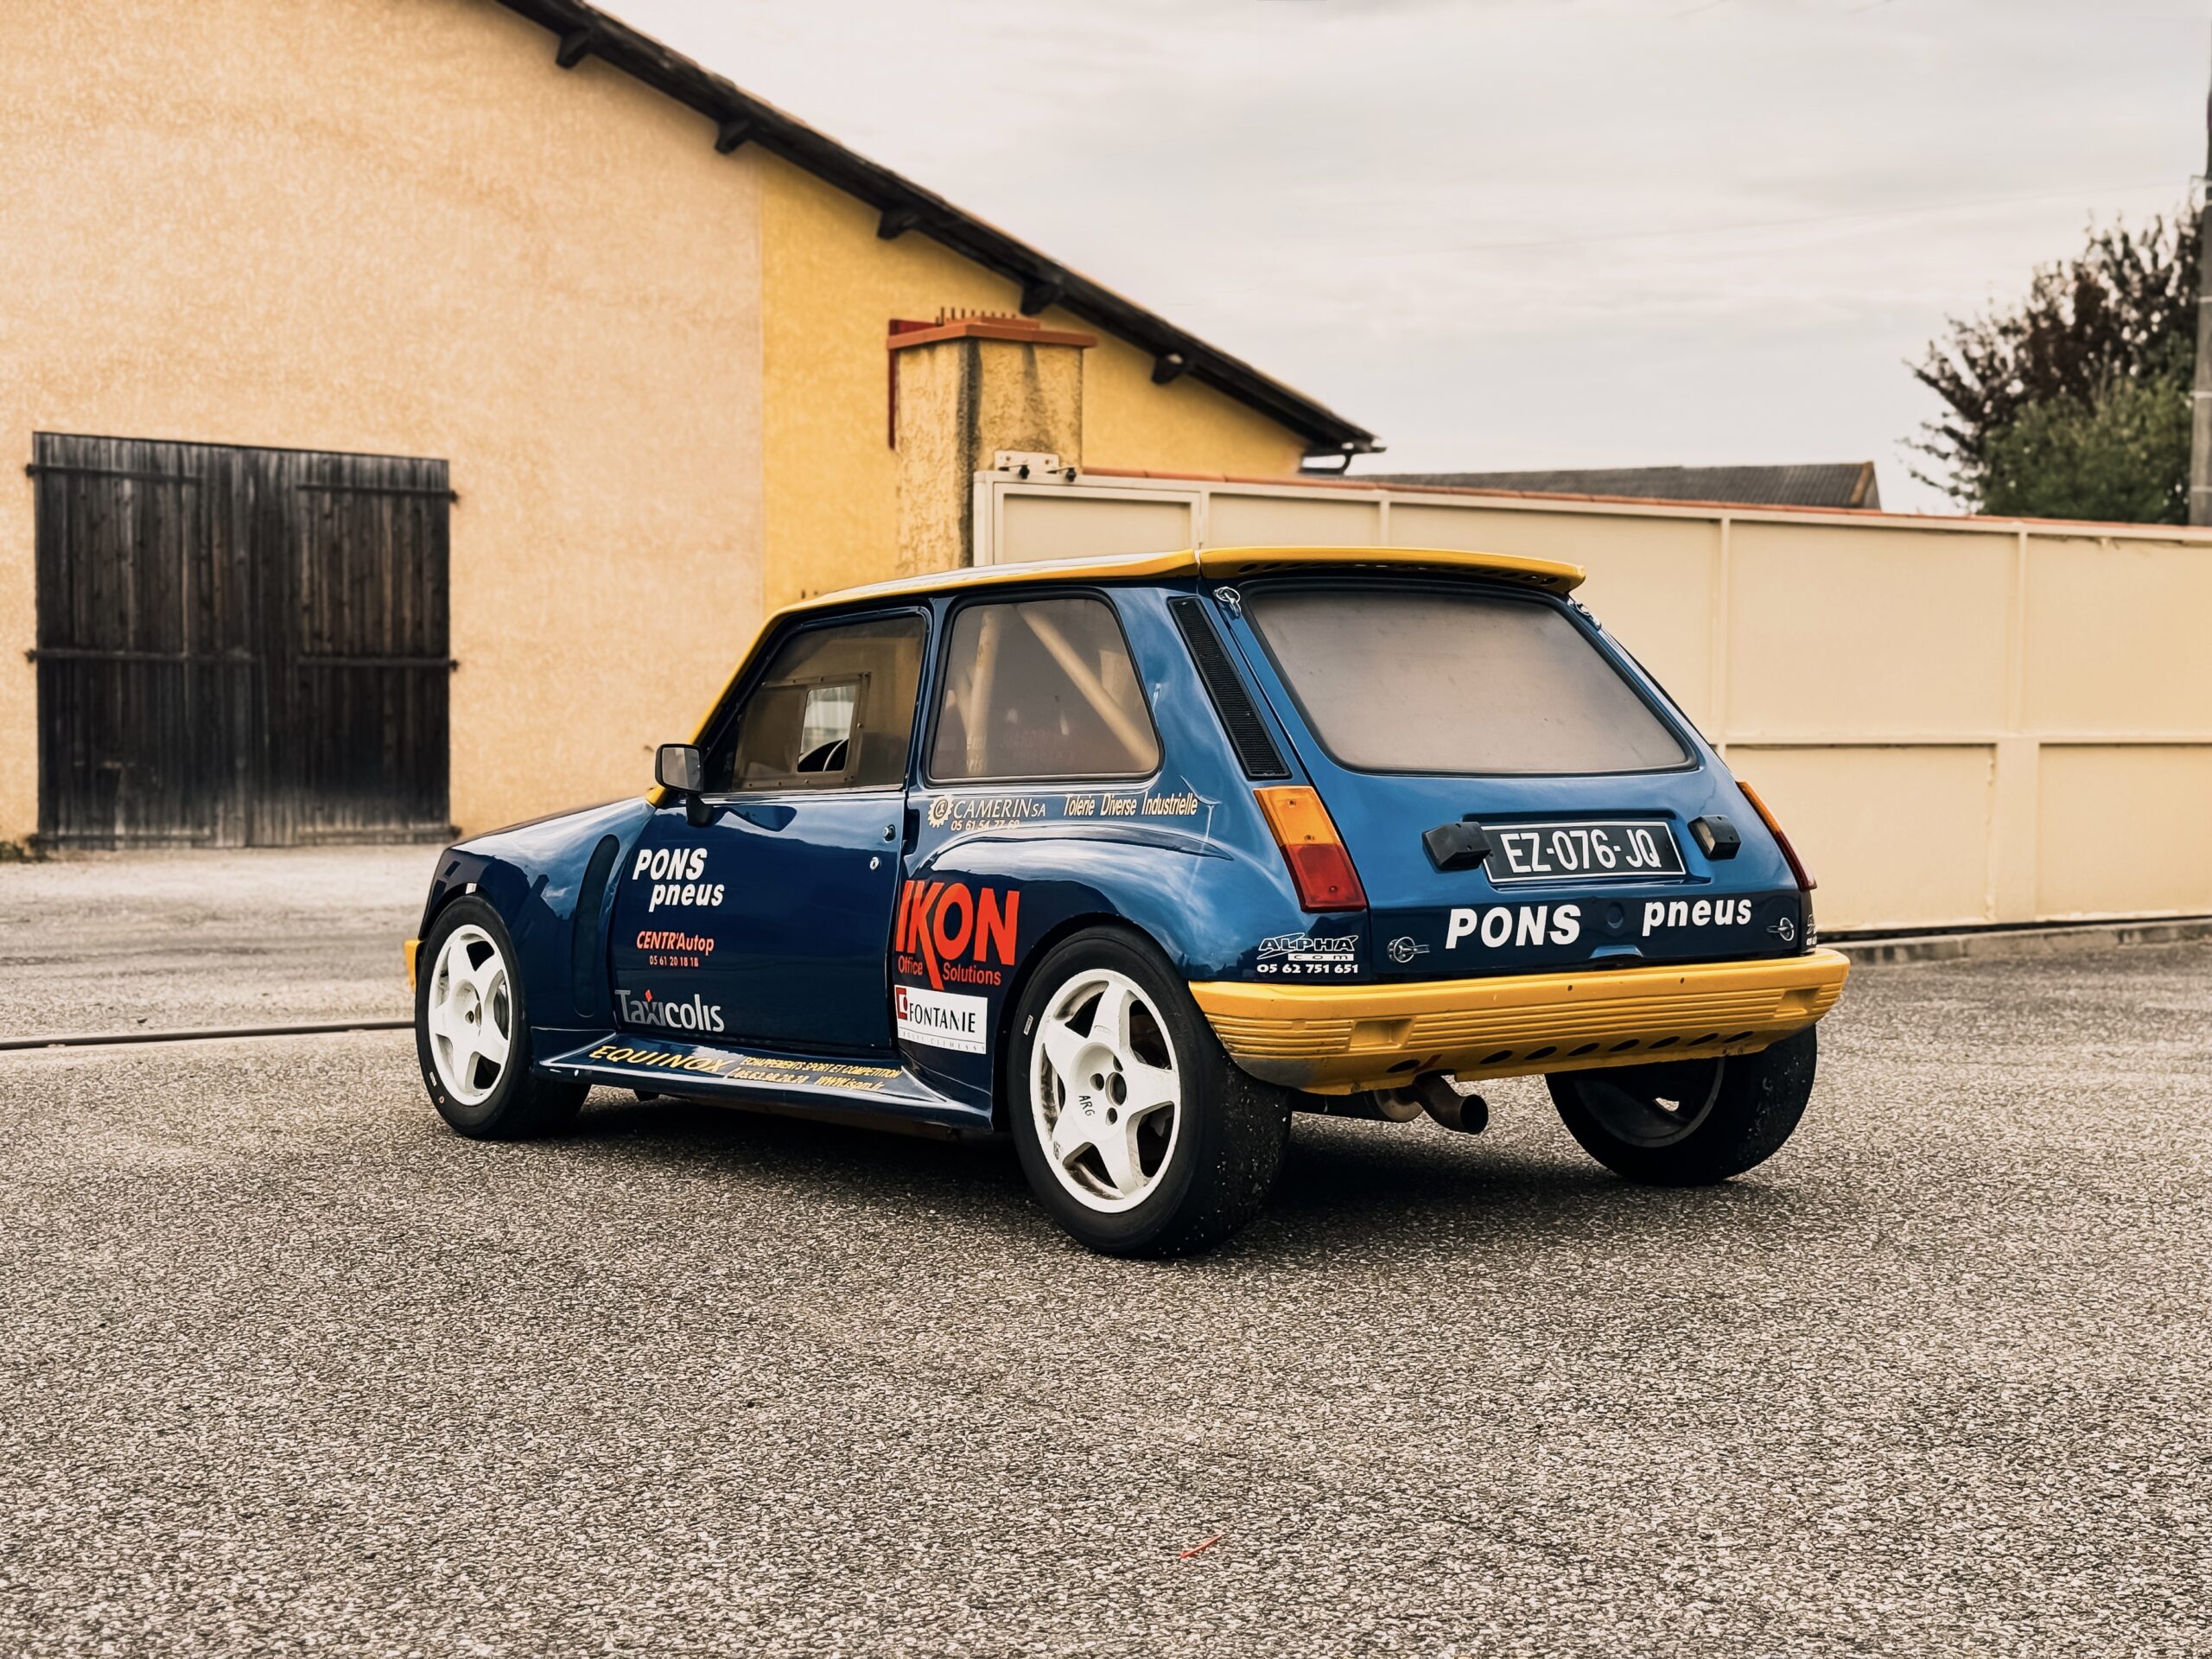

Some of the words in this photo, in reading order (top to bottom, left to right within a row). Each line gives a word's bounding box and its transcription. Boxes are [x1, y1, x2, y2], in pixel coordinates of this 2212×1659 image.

[953, 798, 1033, 819] CAMERIN
[1064, 793, 1096, 817] Tolerie
[1100, 792, 1137, 817] Diverse
[1141, 791, 1198, 816] Industrielle
[950, 819, 963, 831] 05
[965, 819, 976, 830] 61
[632, 847, 708, 880] PONS
[1498, 827, 1662, 874] EZ-076-JQ
[648, 882, 725, 912] pneus
[895, 879, 1020, 991] IKON
[1445, 903, 1582, 950] PONS
[1642, 898, 1752, 938] pneus
[636, 930, 715, 957] CENTR'Autop
[1258, 938, 1356, 951] ALPHA
[649, 955, 658, 966] 05
[659, 956, 667, 966] 61
[670, 956, 678, 967] 20
[680, 957, 688, 968] 18
[898, 955, 924, 976] Office
[942, 962, 1001, 986] Solutions
[1256, 963, 1278, 974] 05
[1281, 963, 1301, 974] 62
[1306, 963, 1330, 974] 751
[1334, 963, 1358, 974] 651
[614, 988, 725, 1033] Taxicolis
[909, 1002, 976, 1033] FONTANIE
[588, 1045, 734, 1073] EQUINOX
[829, 1065, 847, 1073] ET
[1077, 1095, 1096, 1116] ARG
